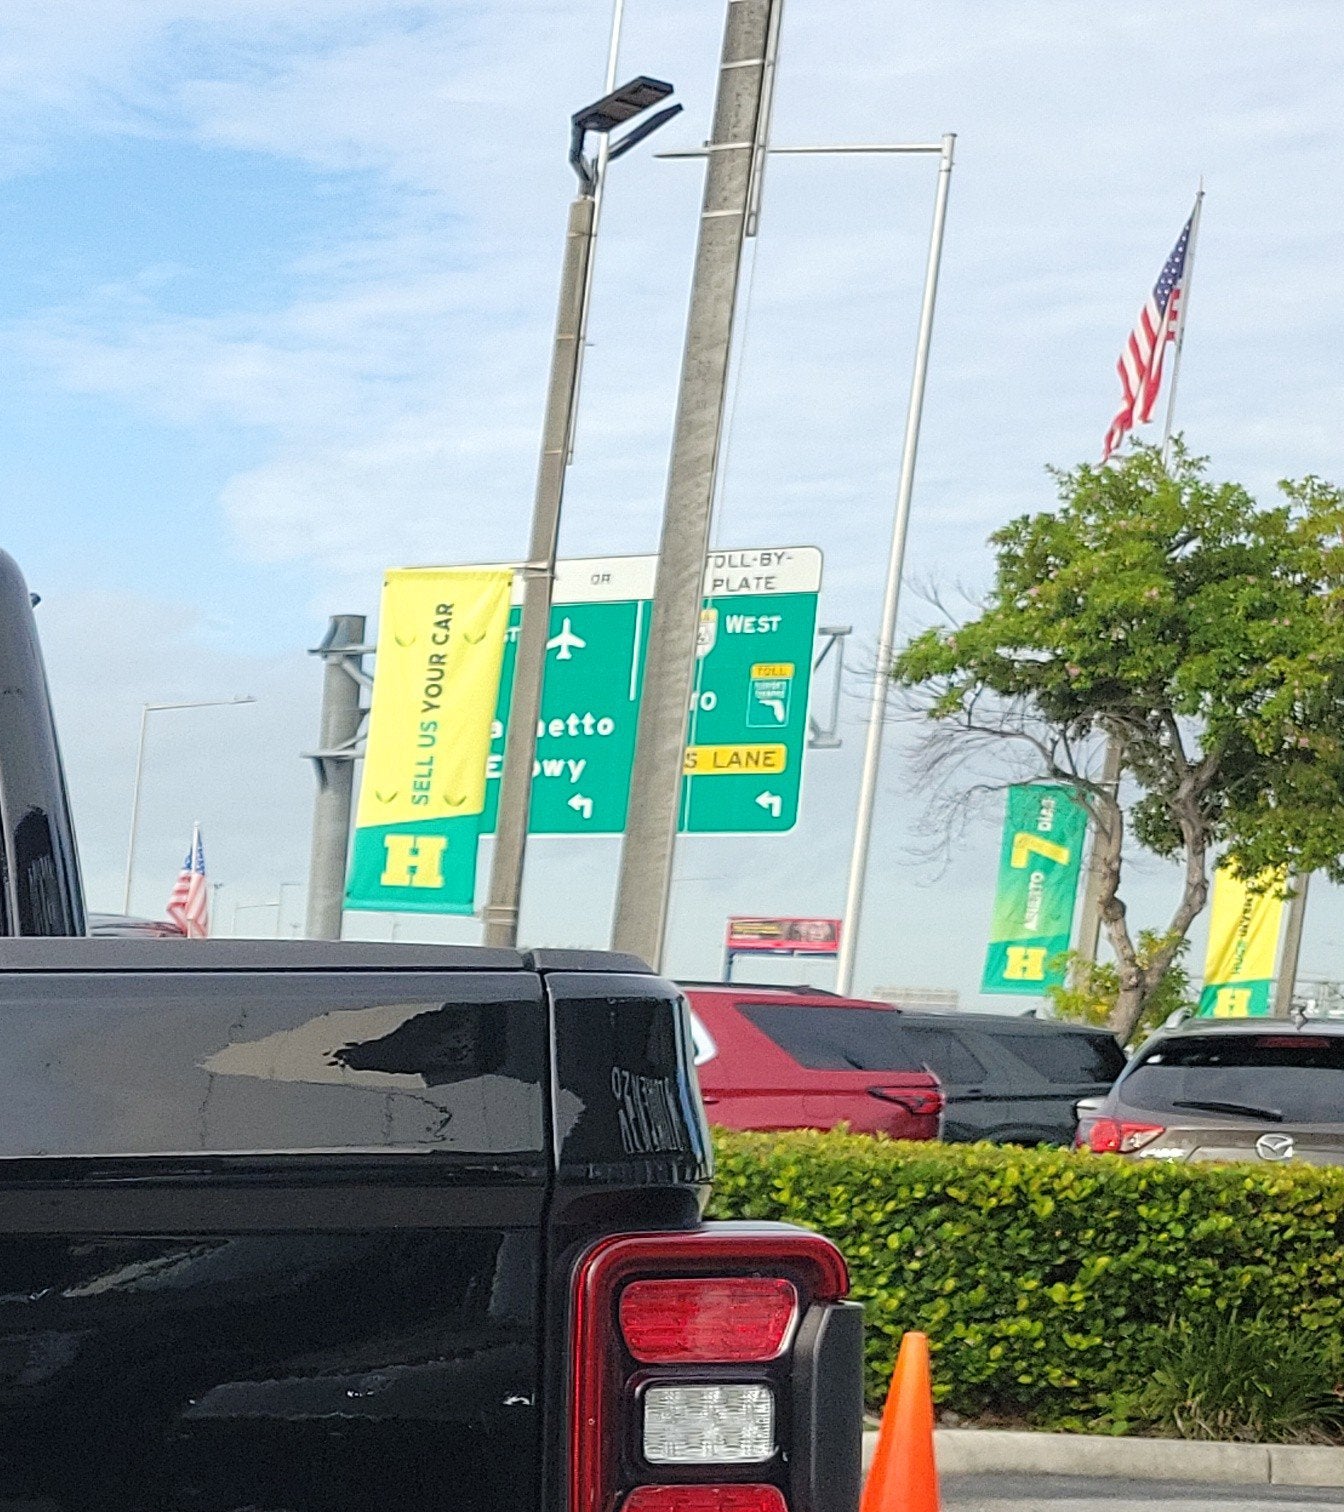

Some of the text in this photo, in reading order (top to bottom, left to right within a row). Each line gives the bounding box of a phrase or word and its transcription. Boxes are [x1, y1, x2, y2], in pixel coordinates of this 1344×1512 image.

[713, 576, 777, 592] PLATE
[725, 614, 782, 634] WEST
[411, 601, 455, 806] SELL US YOUR CAR
[713, 750, 777, 769] LANE
[1011, 831, 1070, 869] 7
